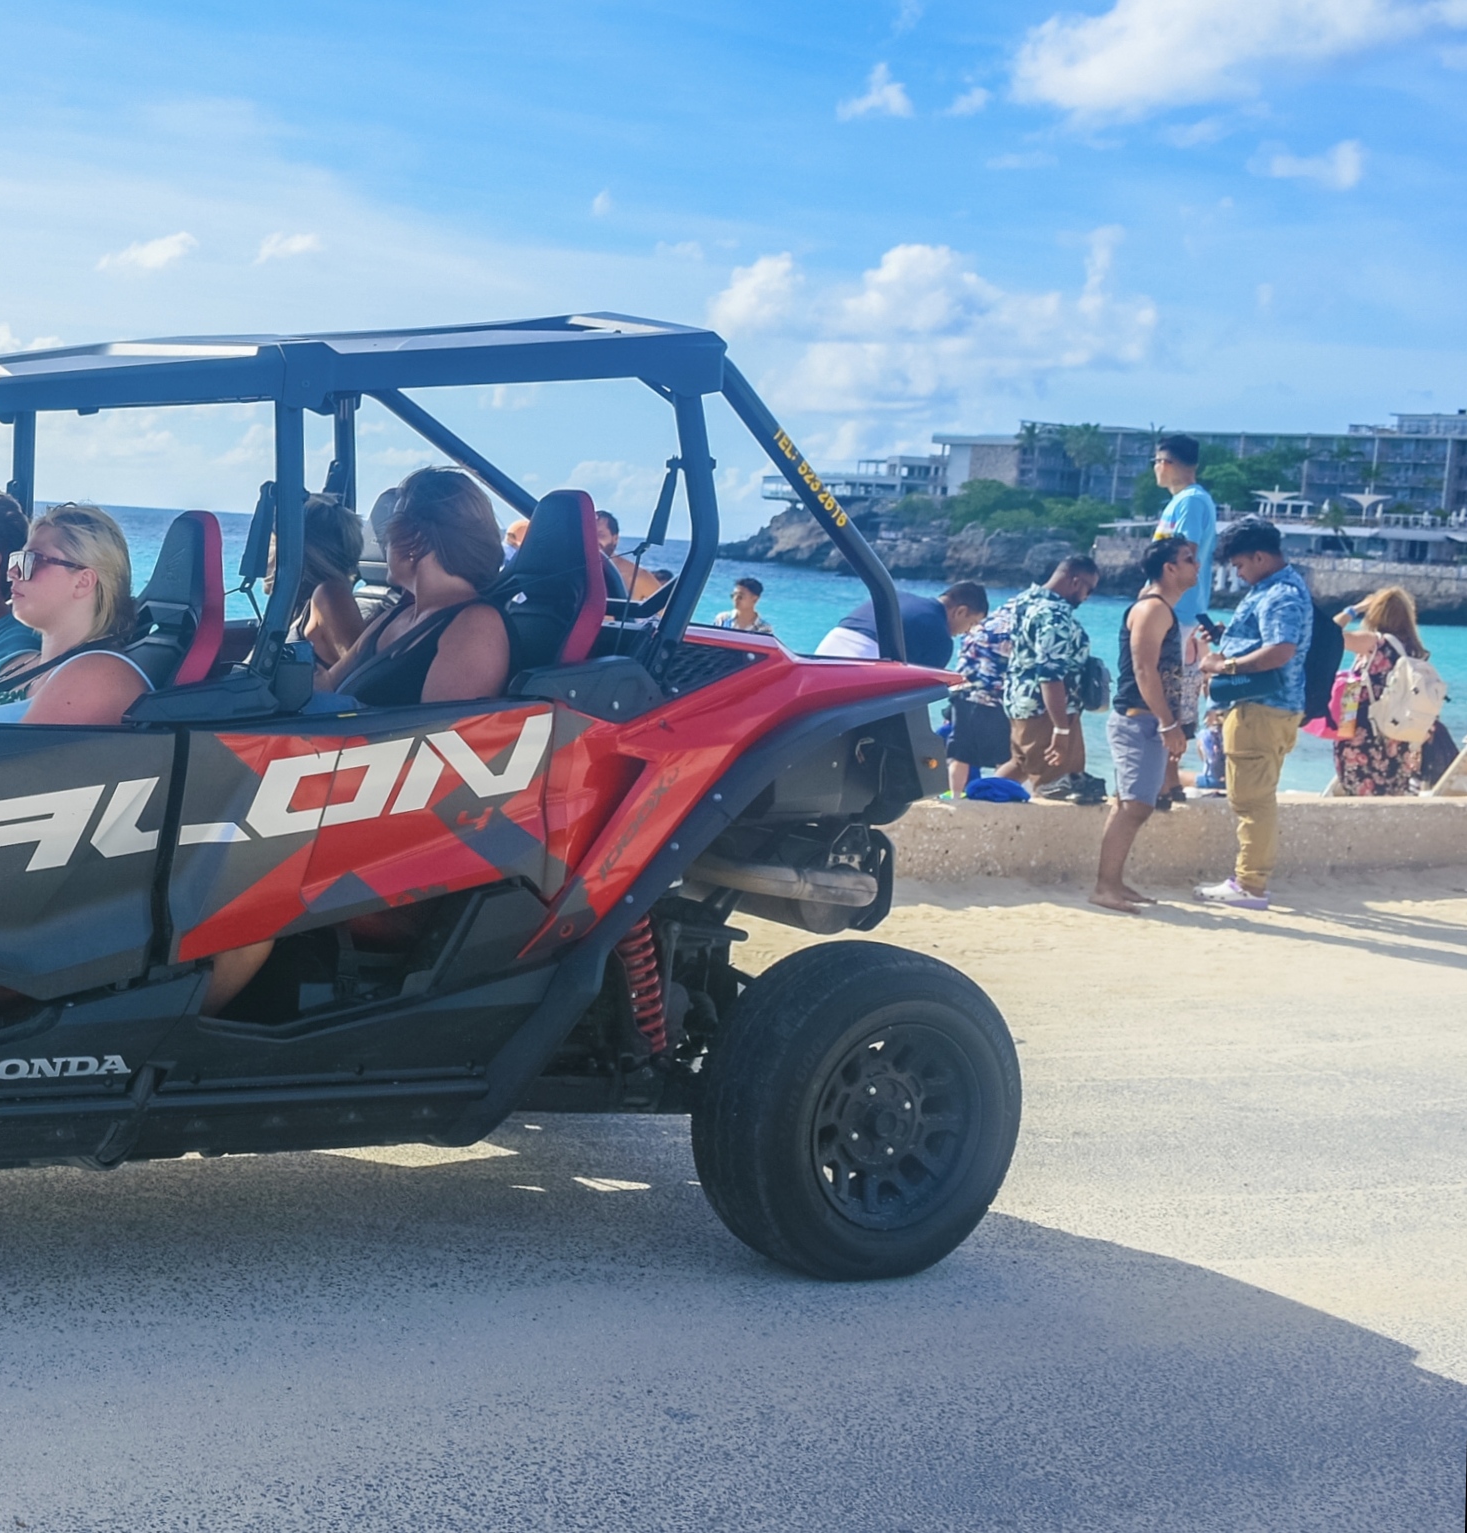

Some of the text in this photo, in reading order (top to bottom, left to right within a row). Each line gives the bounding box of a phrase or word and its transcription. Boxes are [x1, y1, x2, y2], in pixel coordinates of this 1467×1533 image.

[773, 428, 848, 527] TEL: 523 2616
